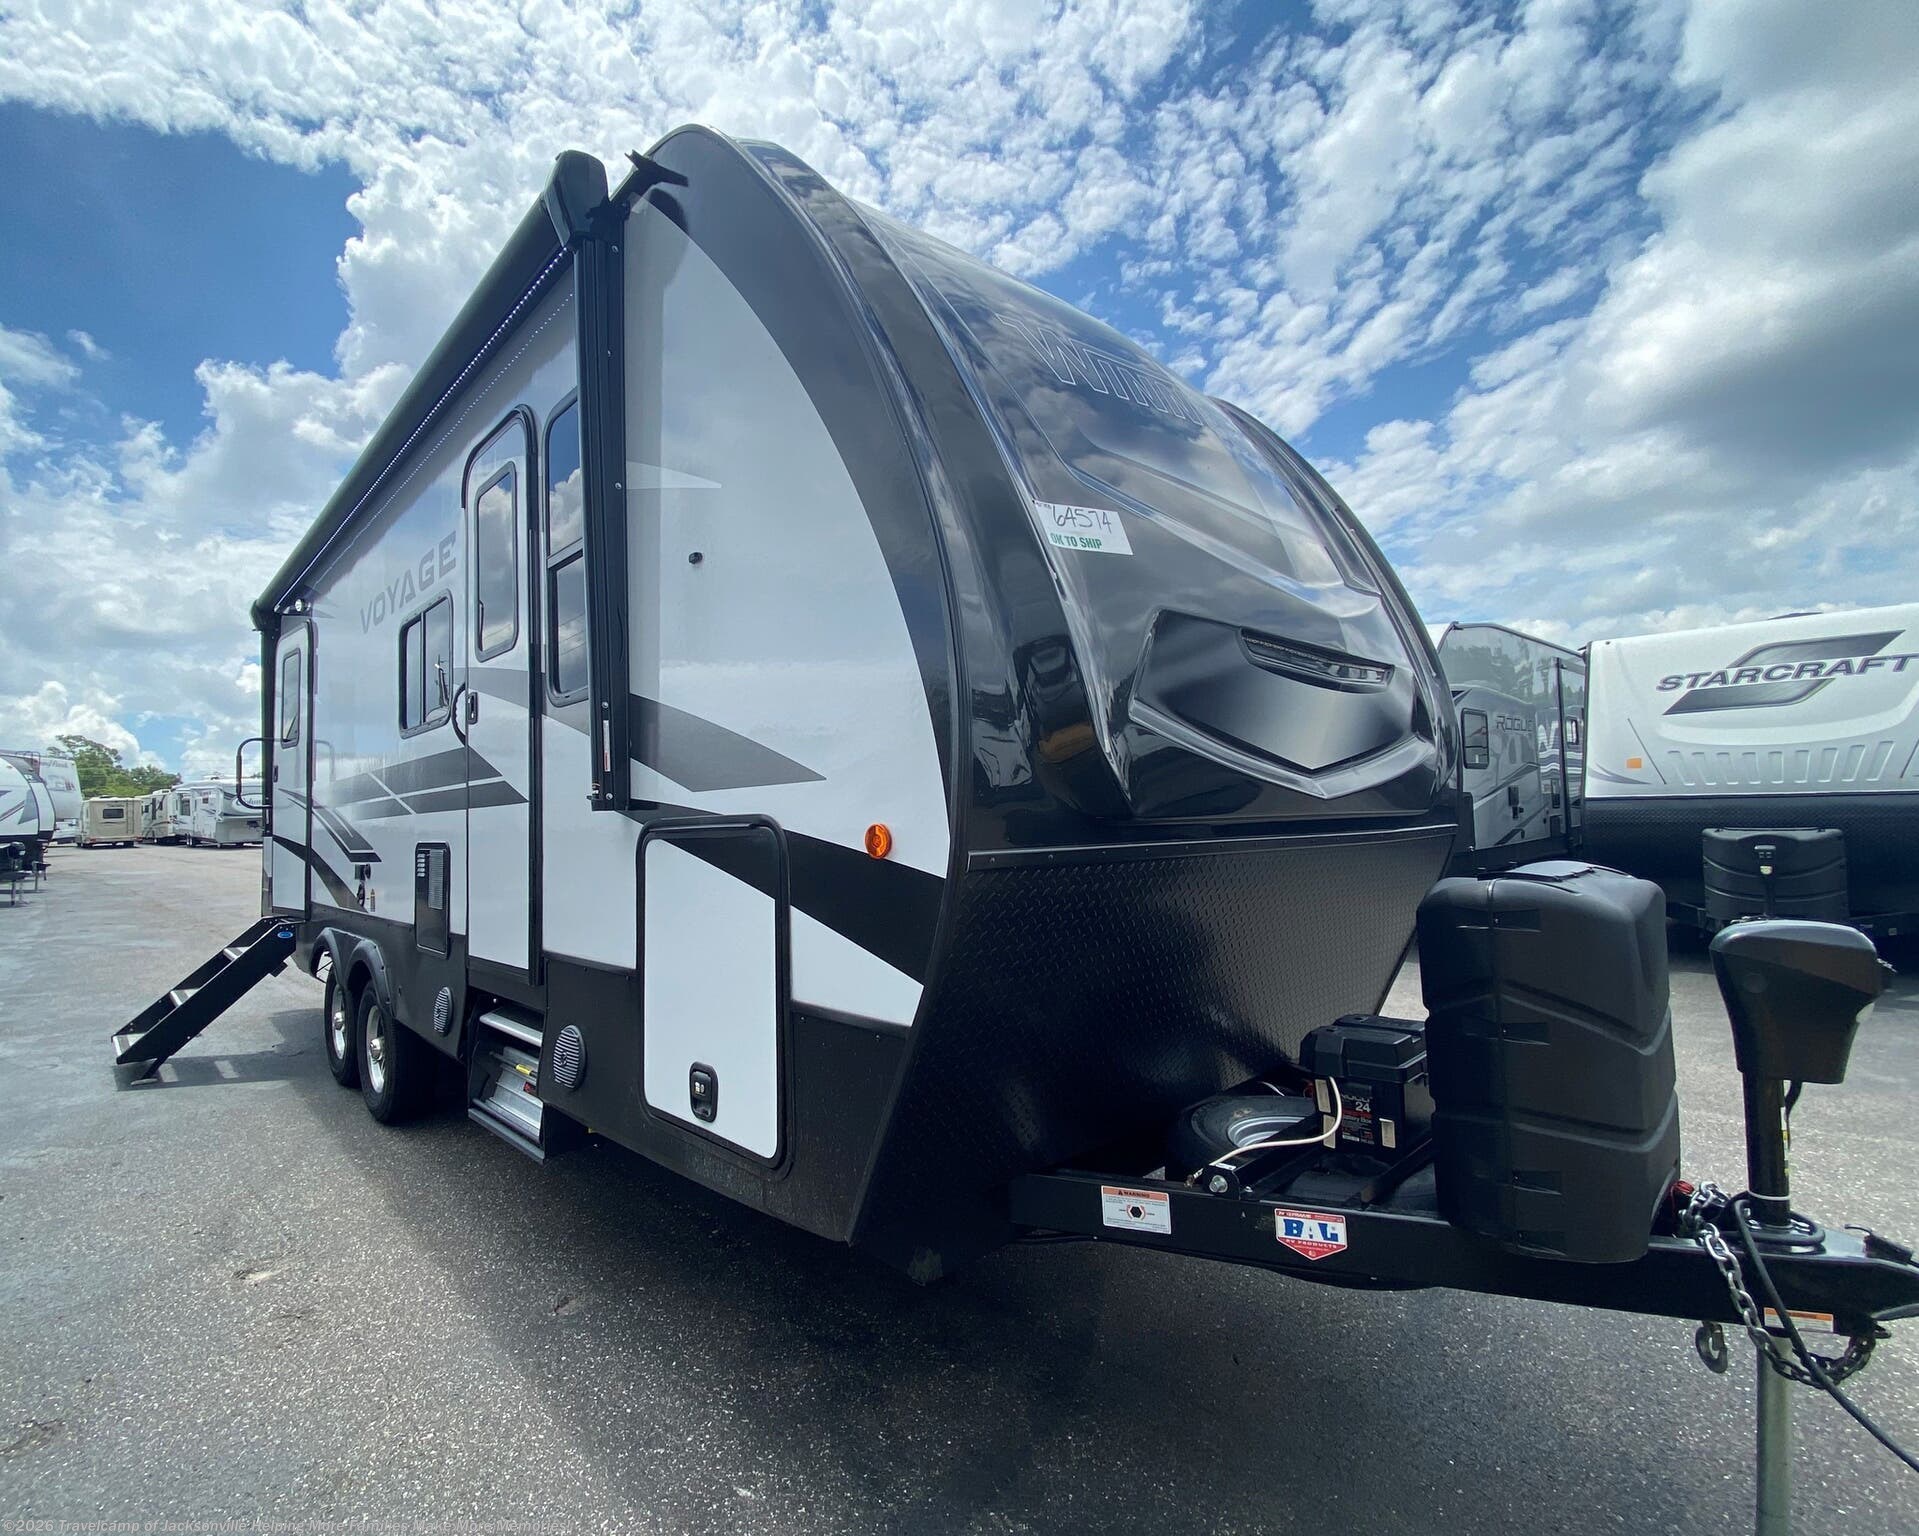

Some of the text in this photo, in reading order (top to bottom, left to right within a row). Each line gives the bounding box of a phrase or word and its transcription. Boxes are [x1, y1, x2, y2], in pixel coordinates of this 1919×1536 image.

[1050, 533, 1103, 550] OK TO SHIP
[360, 530, 457, 635] VOYAGE
[1656, 654, 1919, 692] STARCRAFT
[1496, 715, 1534, 733] ROGUE
[1355, 1101, 1371, 1113] 24
[1283, 1218, 1339, 1243] BAL
[1298, 1239, 1338, 1249] PRODUCTS
